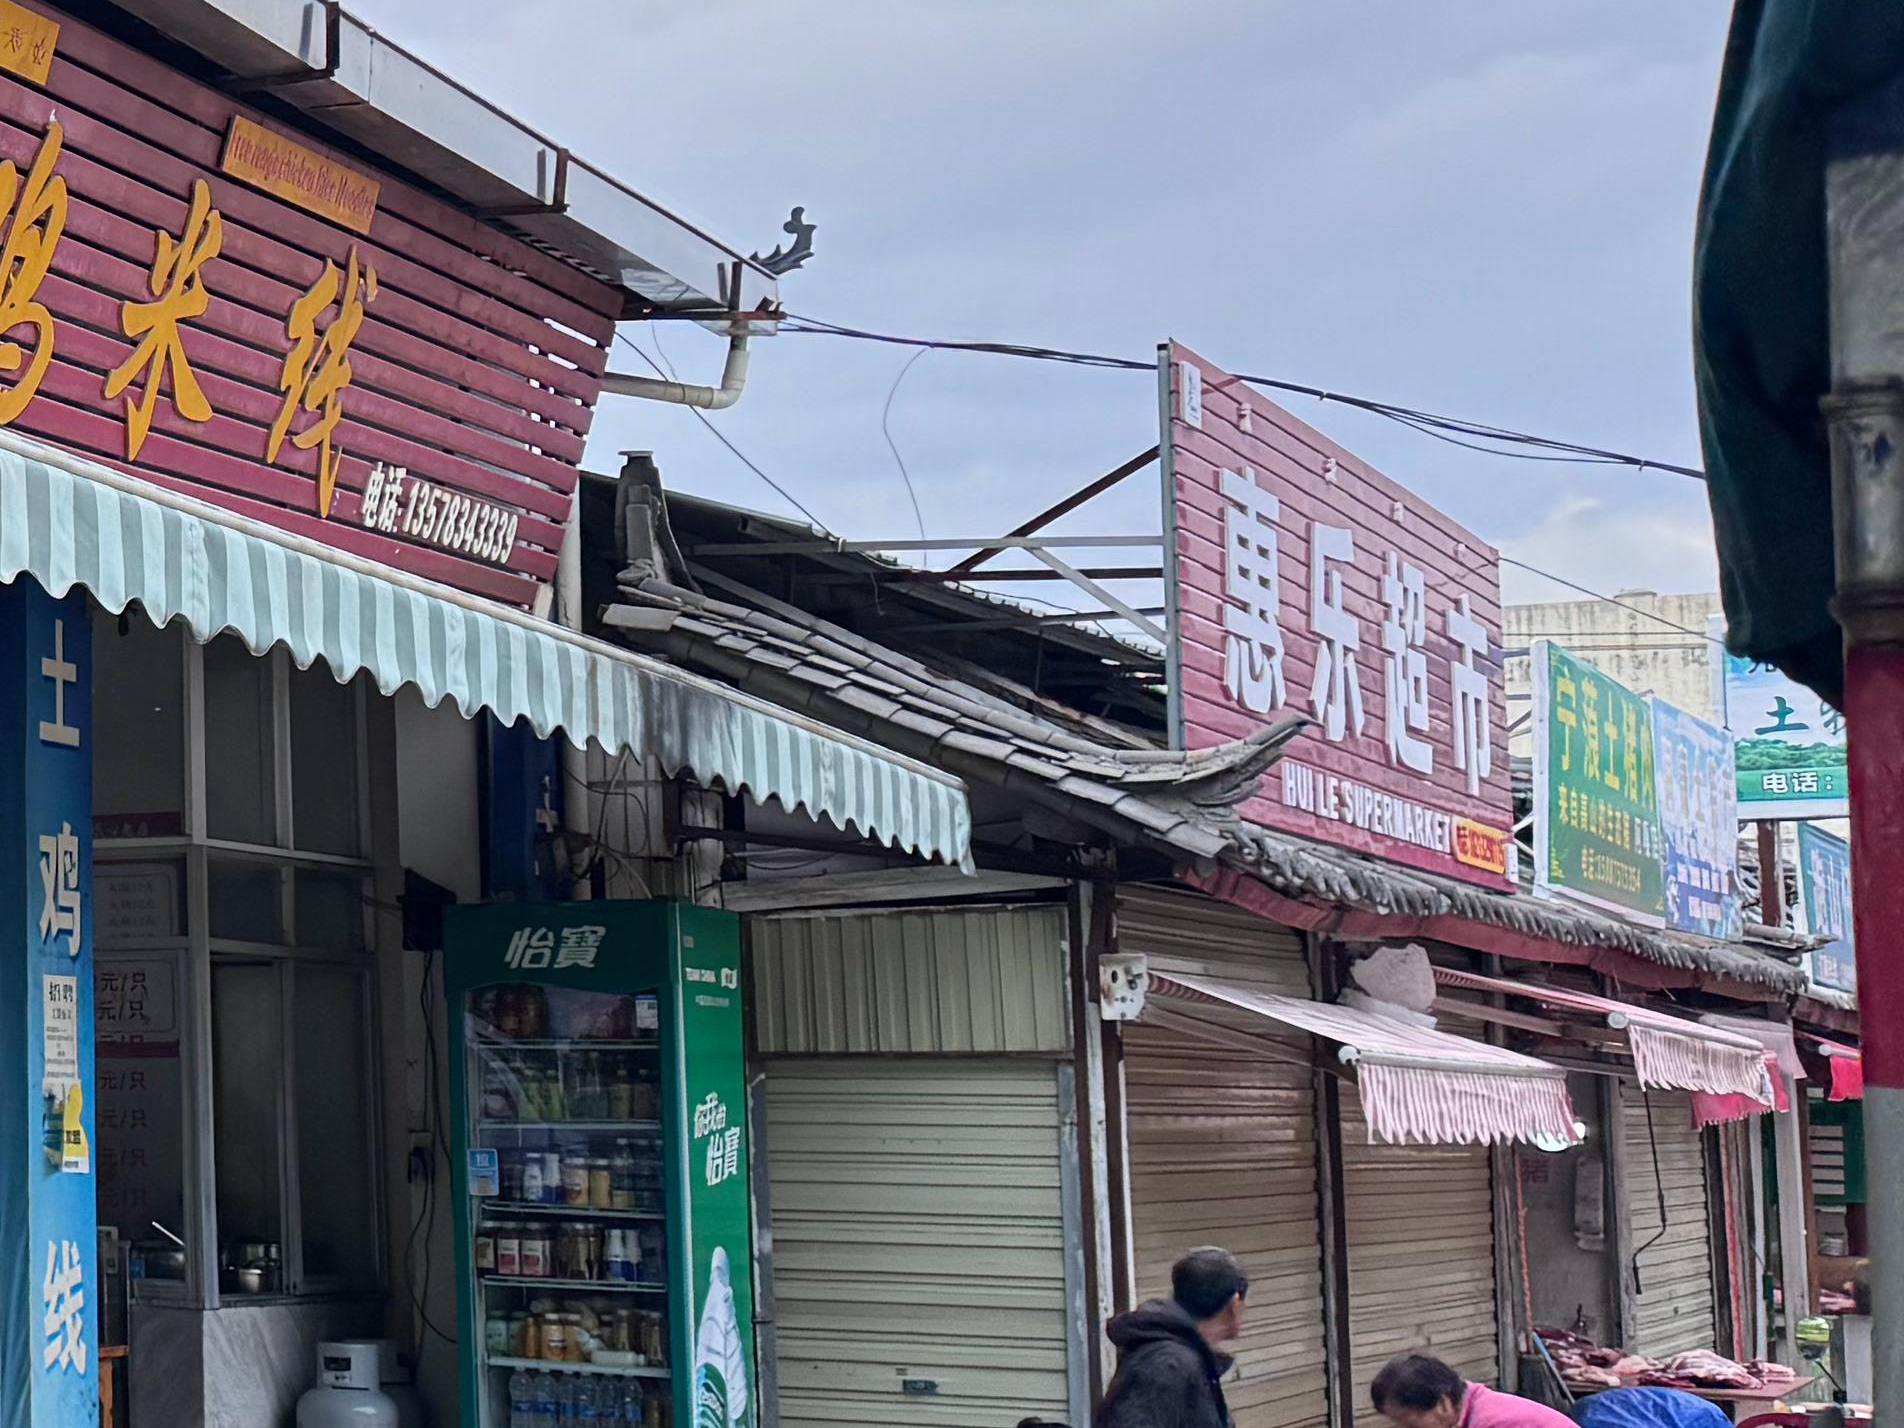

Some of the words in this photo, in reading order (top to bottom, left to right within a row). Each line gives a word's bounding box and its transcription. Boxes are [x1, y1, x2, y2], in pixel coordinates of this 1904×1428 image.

[1219, 467, 1490, 795] 惠乐超市
[1283, 762, 1314, 812] HUI
[1317, 772, 1339, 820] LE
[1341, 780, 1451, 854] SUPERMARKET
[39, 619, 88, 1375] 土鸡线
